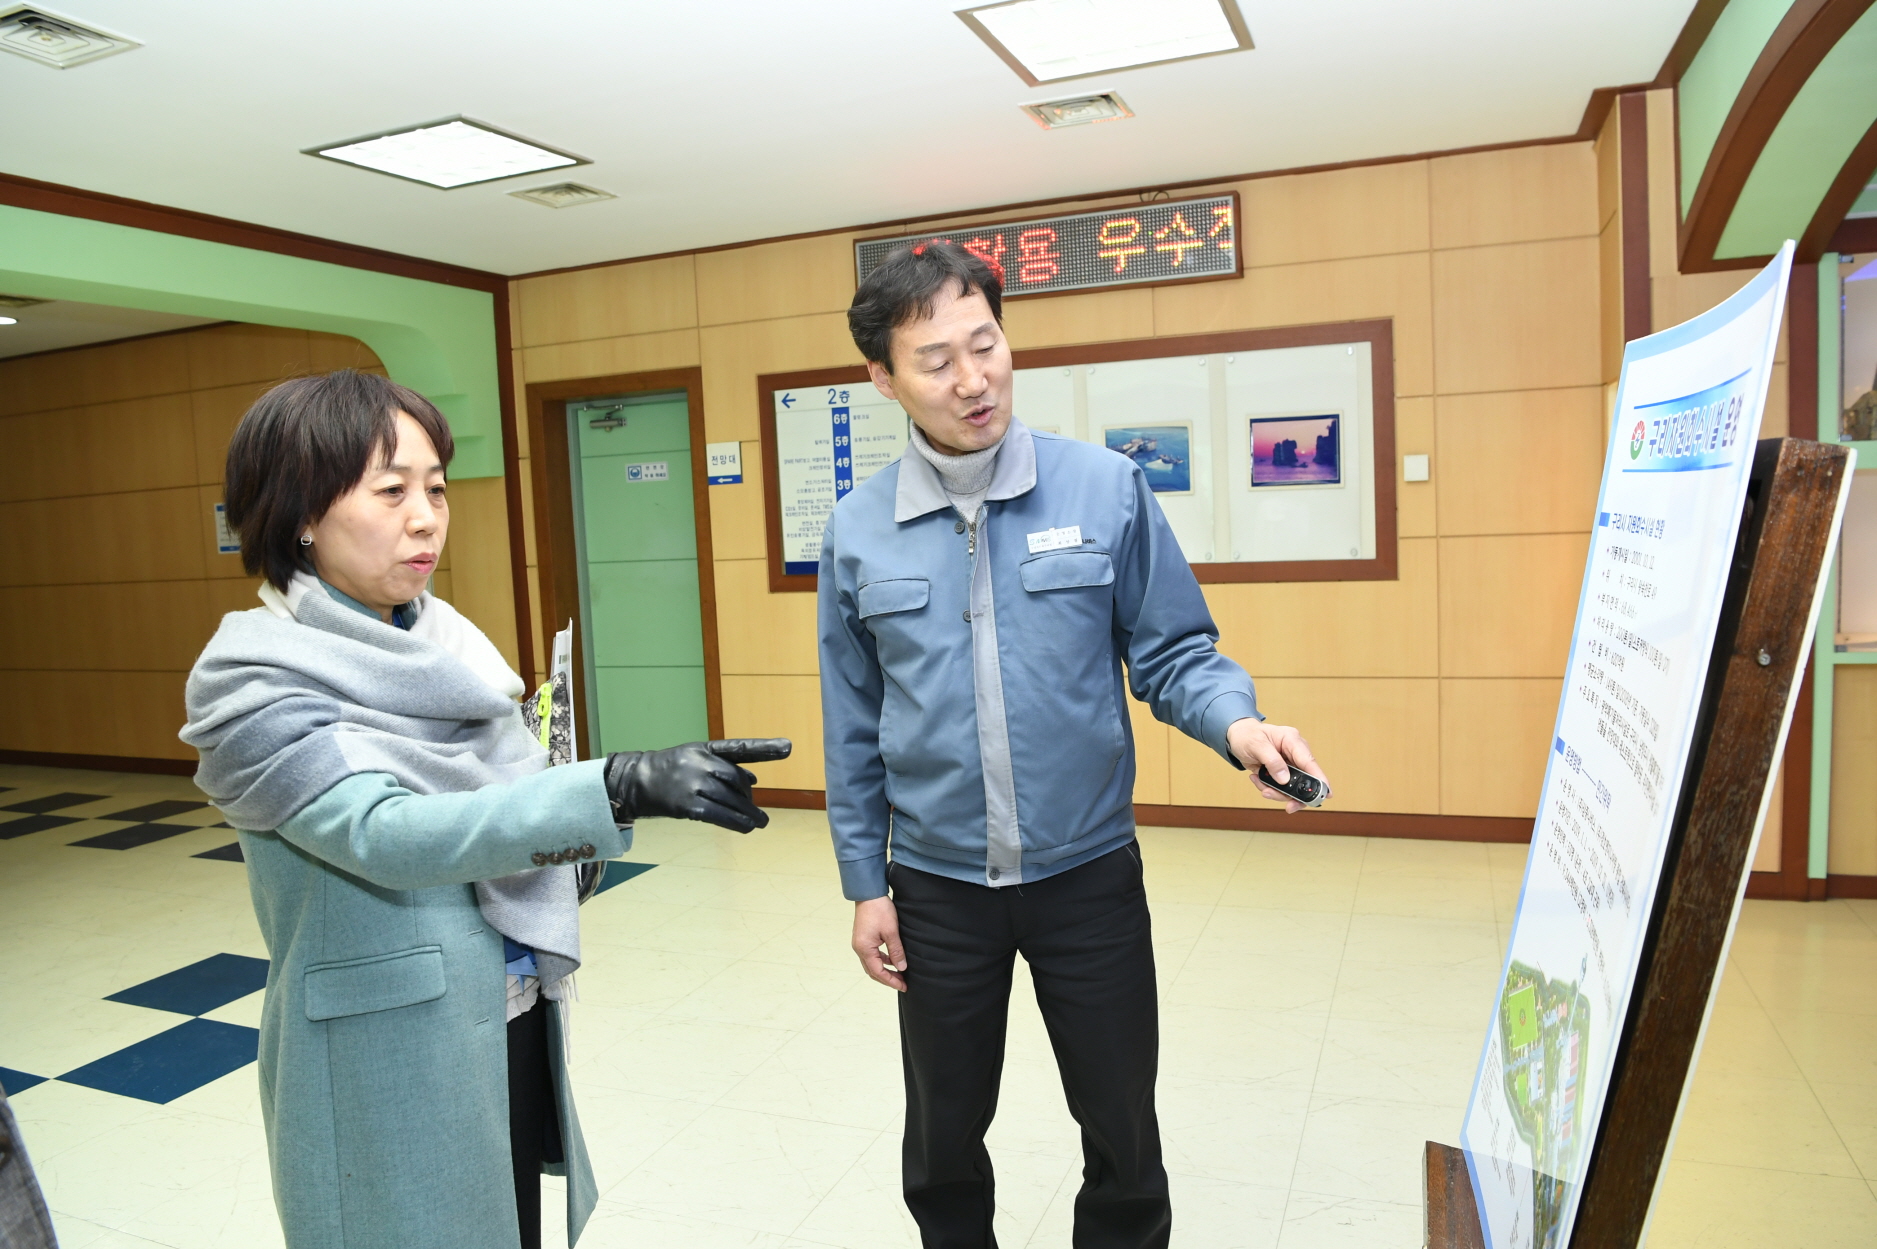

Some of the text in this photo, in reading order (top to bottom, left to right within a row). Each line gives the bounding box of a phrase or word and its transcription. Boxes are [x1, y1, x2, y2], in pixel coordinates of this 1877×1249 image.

[827, 388, 850, 405] 2층
[833, 413, 848, 424] 6층
[835, 435, 849, 447] 5층
[711, 454, 736, 466] 전망대
[836, 457, 850, 468] 4층
[837, 479, 851, 490] 3층
